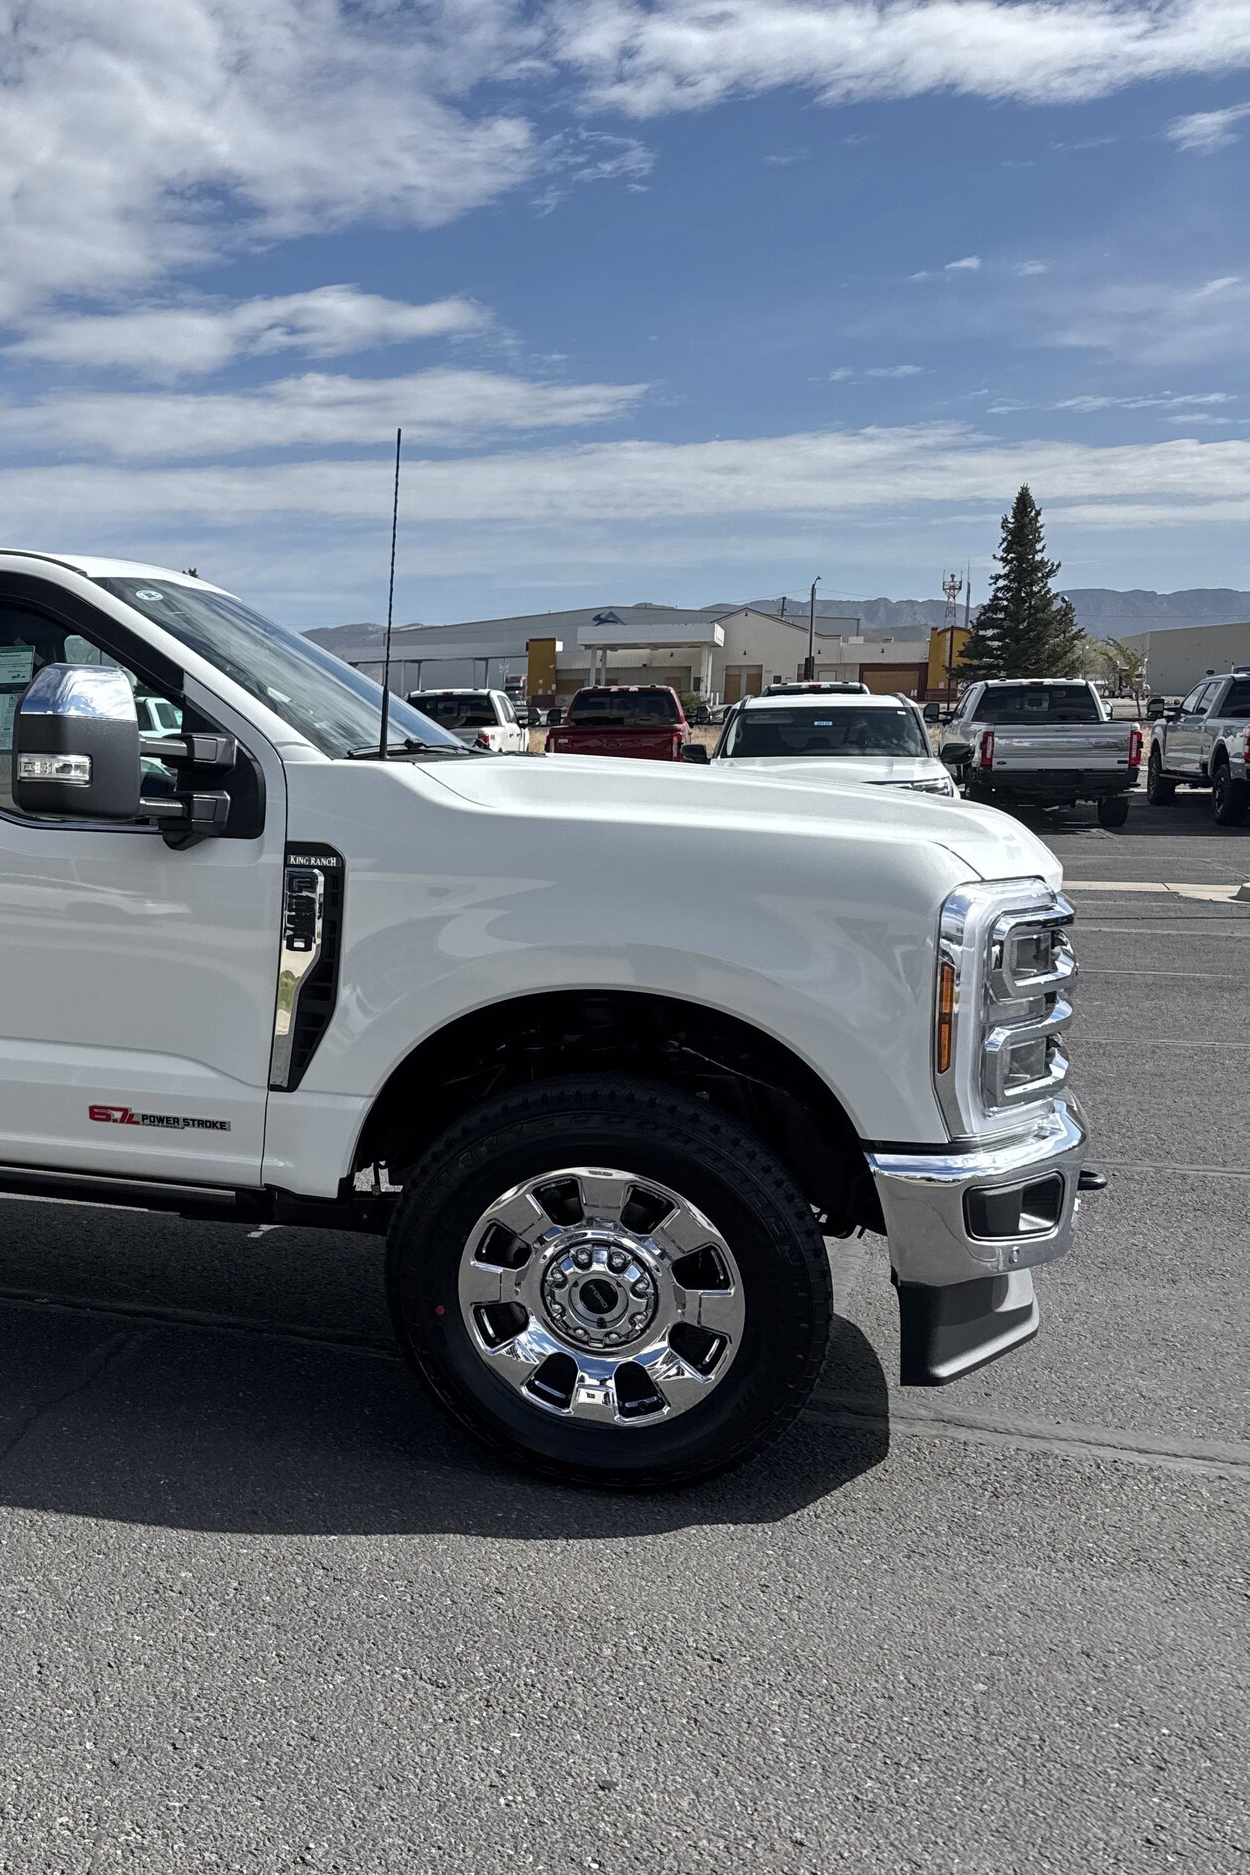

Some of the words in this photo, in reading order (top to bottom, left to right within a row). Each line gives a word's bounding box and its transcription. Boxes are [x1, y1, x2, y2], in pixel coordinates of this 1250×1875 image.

[290, 855, 309, 865] KING
[310, 856, 337, 867] RANCH
[88, 1105, 140, 1126] 6.7L
[141, 1114, 180, 1126] POWER
[182, 1117, 228, 1131] STROKE
